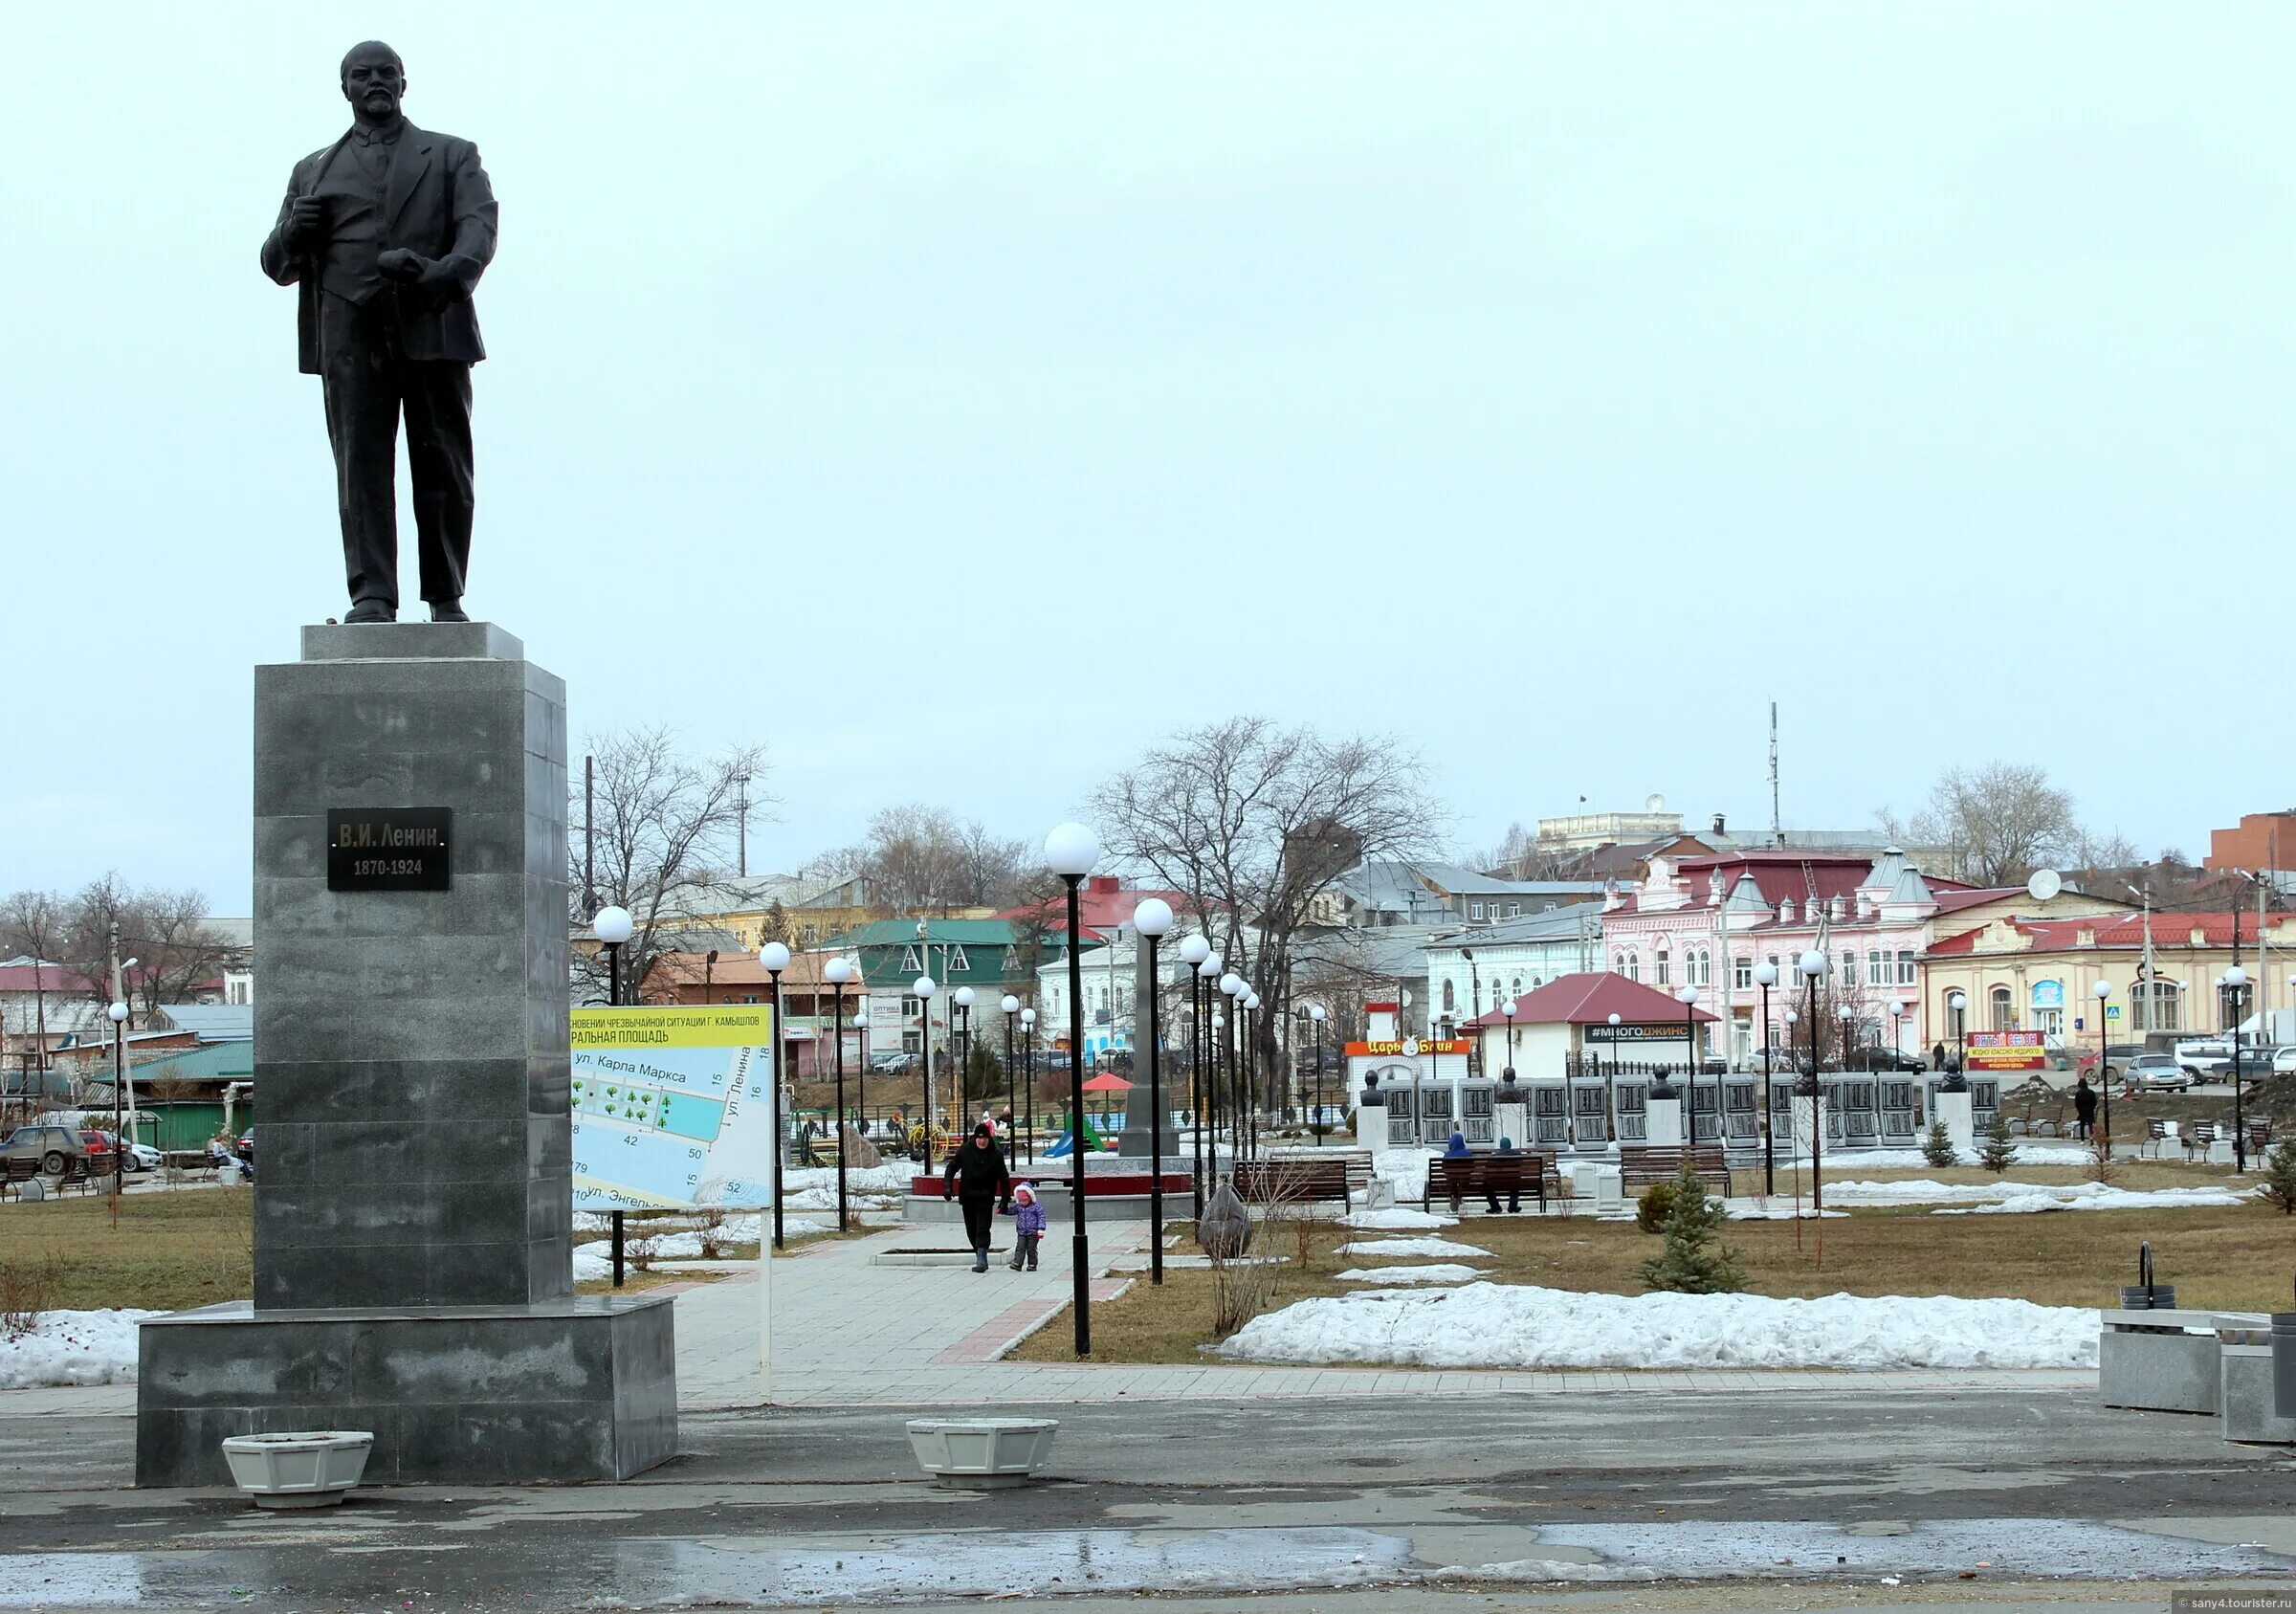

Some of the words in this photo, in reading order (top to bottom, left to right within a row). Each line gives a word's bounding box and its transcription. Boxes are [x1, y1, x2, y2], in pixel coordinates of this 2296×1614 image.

[340, 823, 377, 848] В.И.
[381, 823, 437, 847] Ленин
[354, 859, 423, 875] 1870-1924
[607, 1015, 666, 1028] ЧРЕЗВЫЧАЙНОЙ
[666, 1017, 706, 1028] СИТУАЦИИ
[715, 1015, 761, 1027] КАМЫШЛОВ
[618, 1029, 669, 1044] ПЛОЩАДЬ
[1592, 1027, 1689, 1038] #МНОГОДЖИНС
[1974, 1032, 2007, 1047] ПЯТЫЙ
[2007, 1033, 2038, 1047] СЕЗОН
[760, 1047, 770, 1060] 18
[1368, 1041, 1401, 1054] Царь
[575, 1052, 593, 1065] ул.
[597, 1055, 635, 1073] Карла
[639, 1063, 687, 1083] Маркса
[730, 1046, 751, 1094] Ленина
[712, 1072, 723, 1088] 15
[751, 1086, 762, 1098] 16
[728, 1098, 739, 1117] ул.
[570, 1124, 580, 1135] 8
[624, 1135, 638, 1146] 42
[688, 1148, 702, 1160] 50
[571, 1161, 588, 1174] 79
[687, 1173, 697, 1186] 15
[570, 1186, 587, 1202] 10
[726, 1182, 741, 1194] 52
[586, 1185, 605, 1199] ул.
[608, 1189, 665, 1208] Энгель
